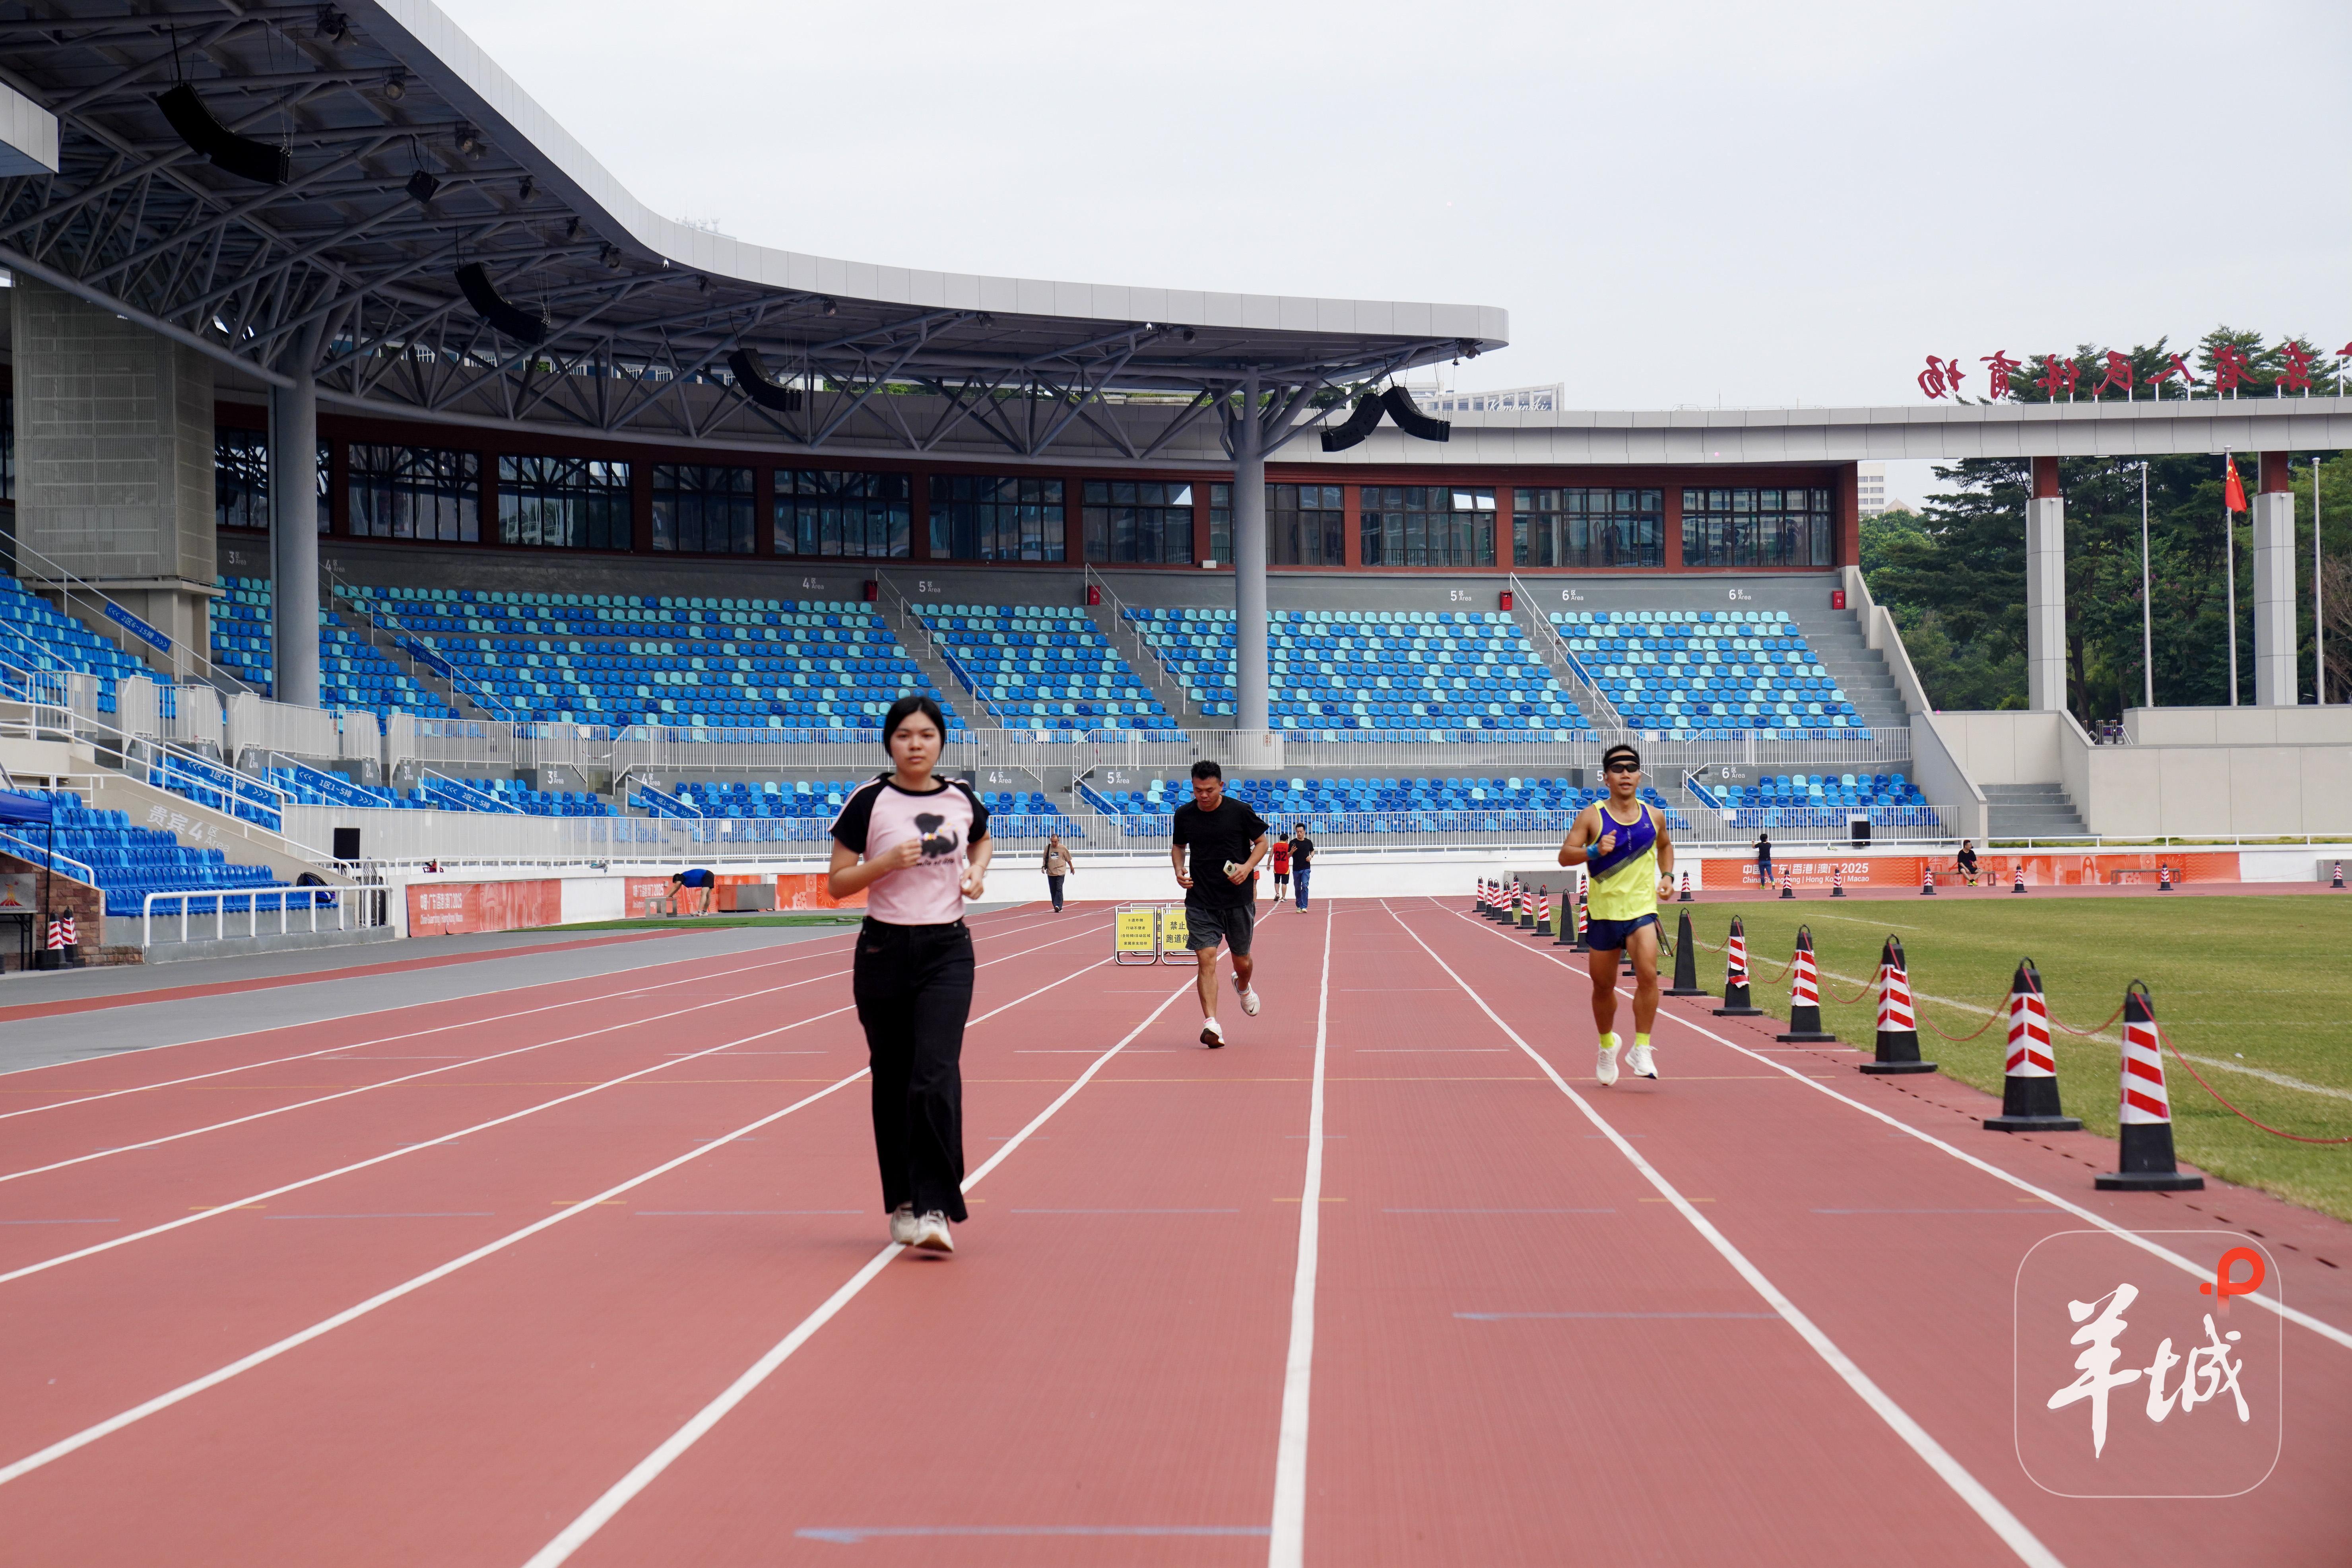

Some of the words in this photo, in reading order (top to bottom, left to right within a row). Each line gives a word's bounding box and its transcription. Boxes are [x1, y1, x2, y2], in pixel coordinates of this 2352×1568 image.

[803, 578, 809, 589] 4
[919, 581, 926, 592] 5
[1451, 590, 1457, 601] 5
[1562, 590, 1569, 600] 6
[1729, 589, 1736, 600] 6
[404, 766, 408, 780] 3
[548, 771, 553, 784] 3
[989, 772, 996, 783] 4
[1107, 772, 1114, 784] 5
[1597, 770, 1603, 782] 5
[1722, 767, 1729, 778] 6
[204, 836, 230, 853] Area
[1275, 851, 1287, 861] 32
[1841, 863, 1869, 873] 2025
[1170, 921, 1186, 930] 禁止
